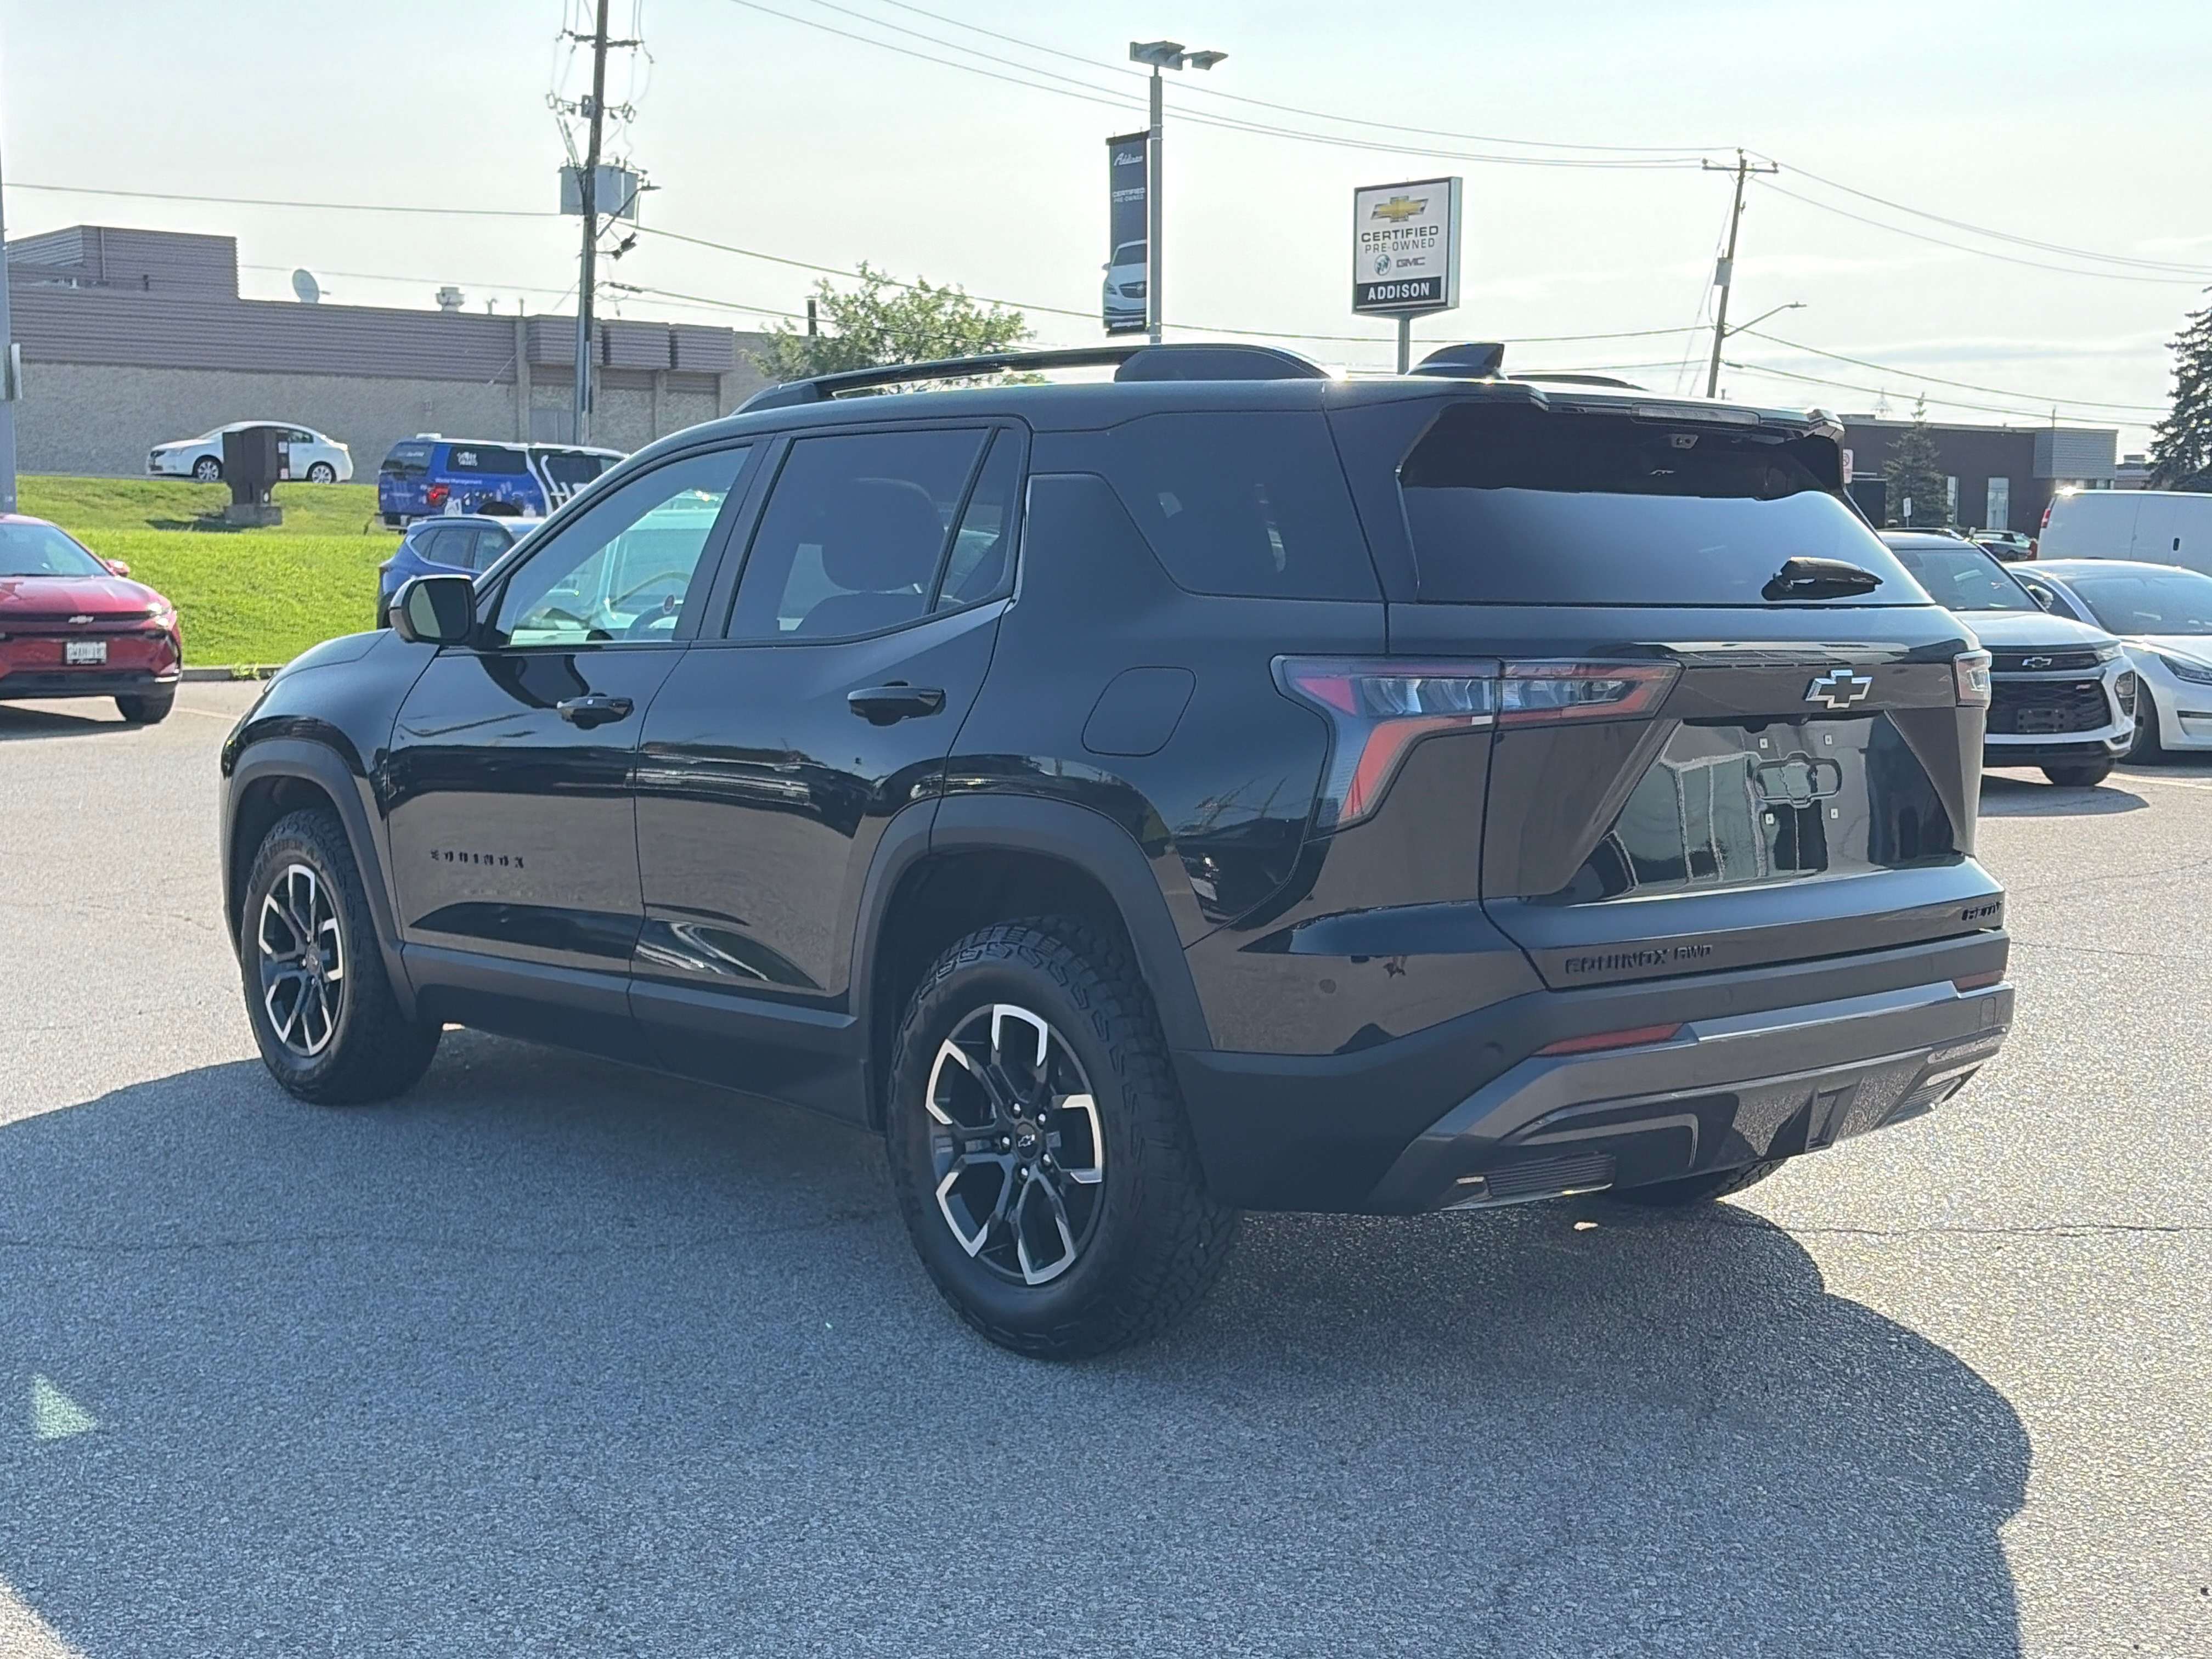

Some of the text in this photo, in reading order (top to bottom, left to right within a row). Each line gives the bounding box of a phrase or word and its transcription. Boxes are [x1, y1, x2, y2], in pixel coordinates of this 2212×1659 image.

[1361, 225, 1439, 242] CERTIFIED
[1365, 238, 1435, 254] PRE-OWNED
[1396, 256, 1426, 268] GMC
[1368, 282, 1430, 301] ADDISON
[1565, 947, 1671, 974] EQUINOX
